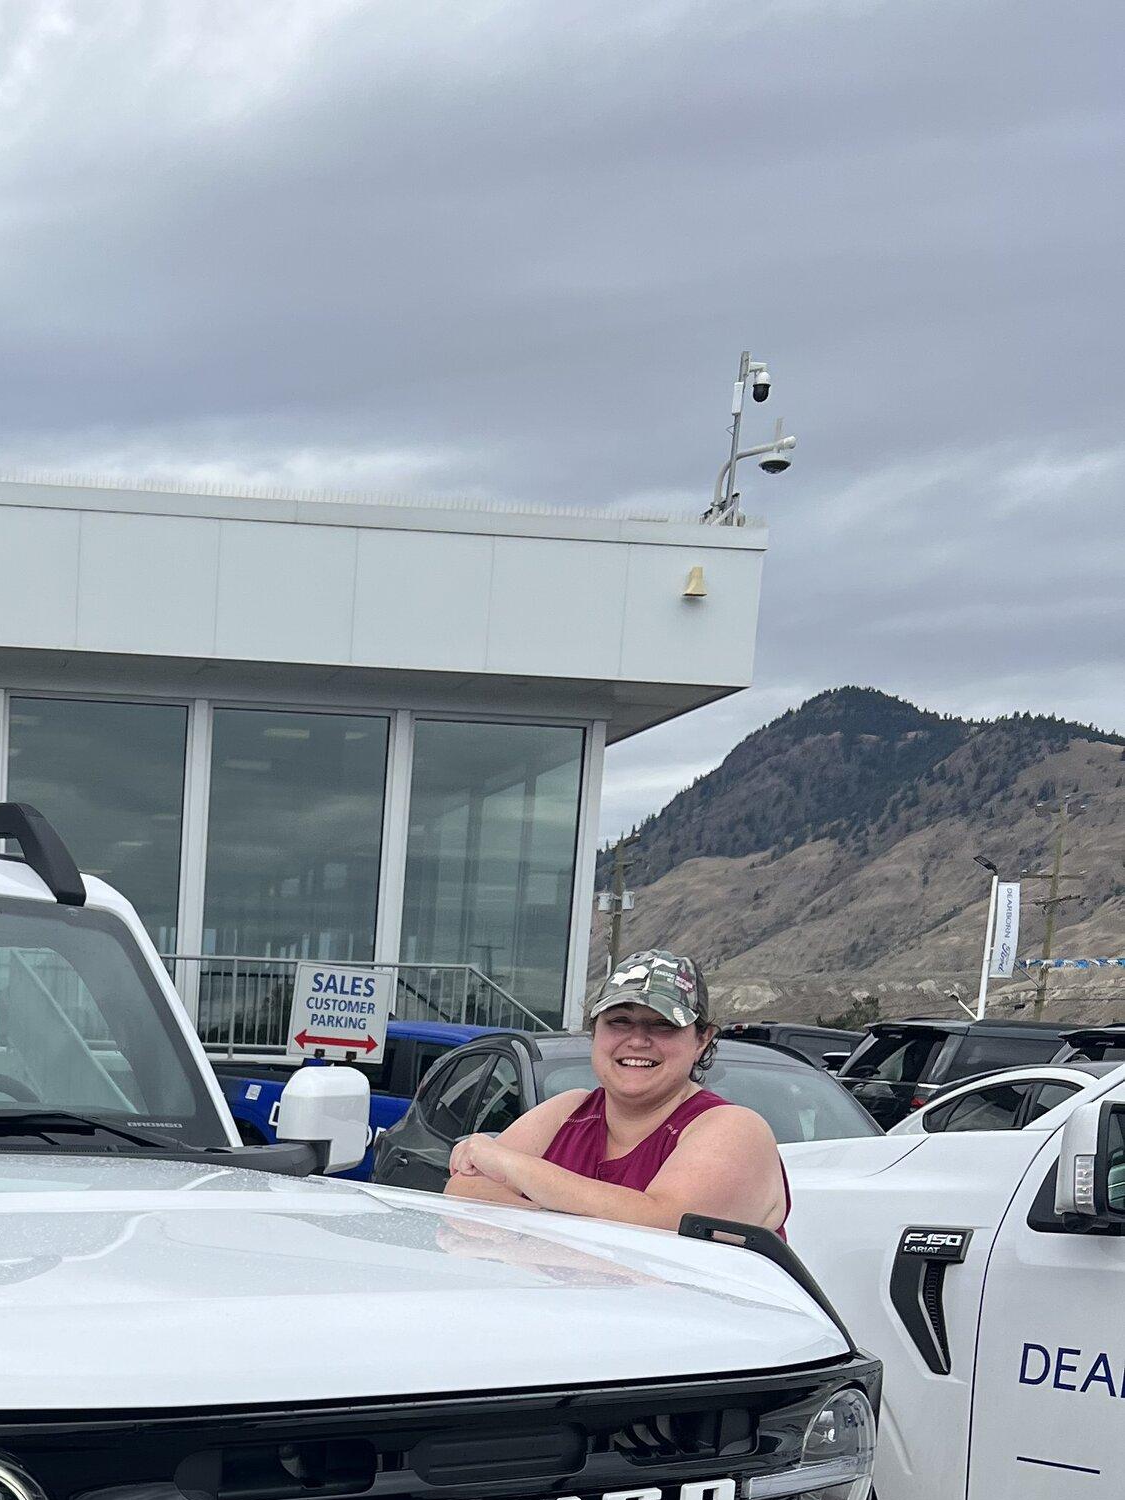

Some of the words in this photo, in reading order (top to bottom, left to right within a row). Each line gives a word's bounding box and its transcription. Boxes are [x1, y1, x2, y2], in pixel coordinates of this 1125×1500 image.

[1005, 888, 1013, 938] DEARBORN
[999, 943, 1011, 972] Ford
[312, 973, 376, 998] SALES
[306, 997, 376, 1015] CUSTOMER
[311, 1014, 367, 1030] PARKING
[903, 1231, 963, 1247] F-150
[903, 1245, 941, 1254] LARIAT
[1018, 1342, 1125, 1399] DEA
